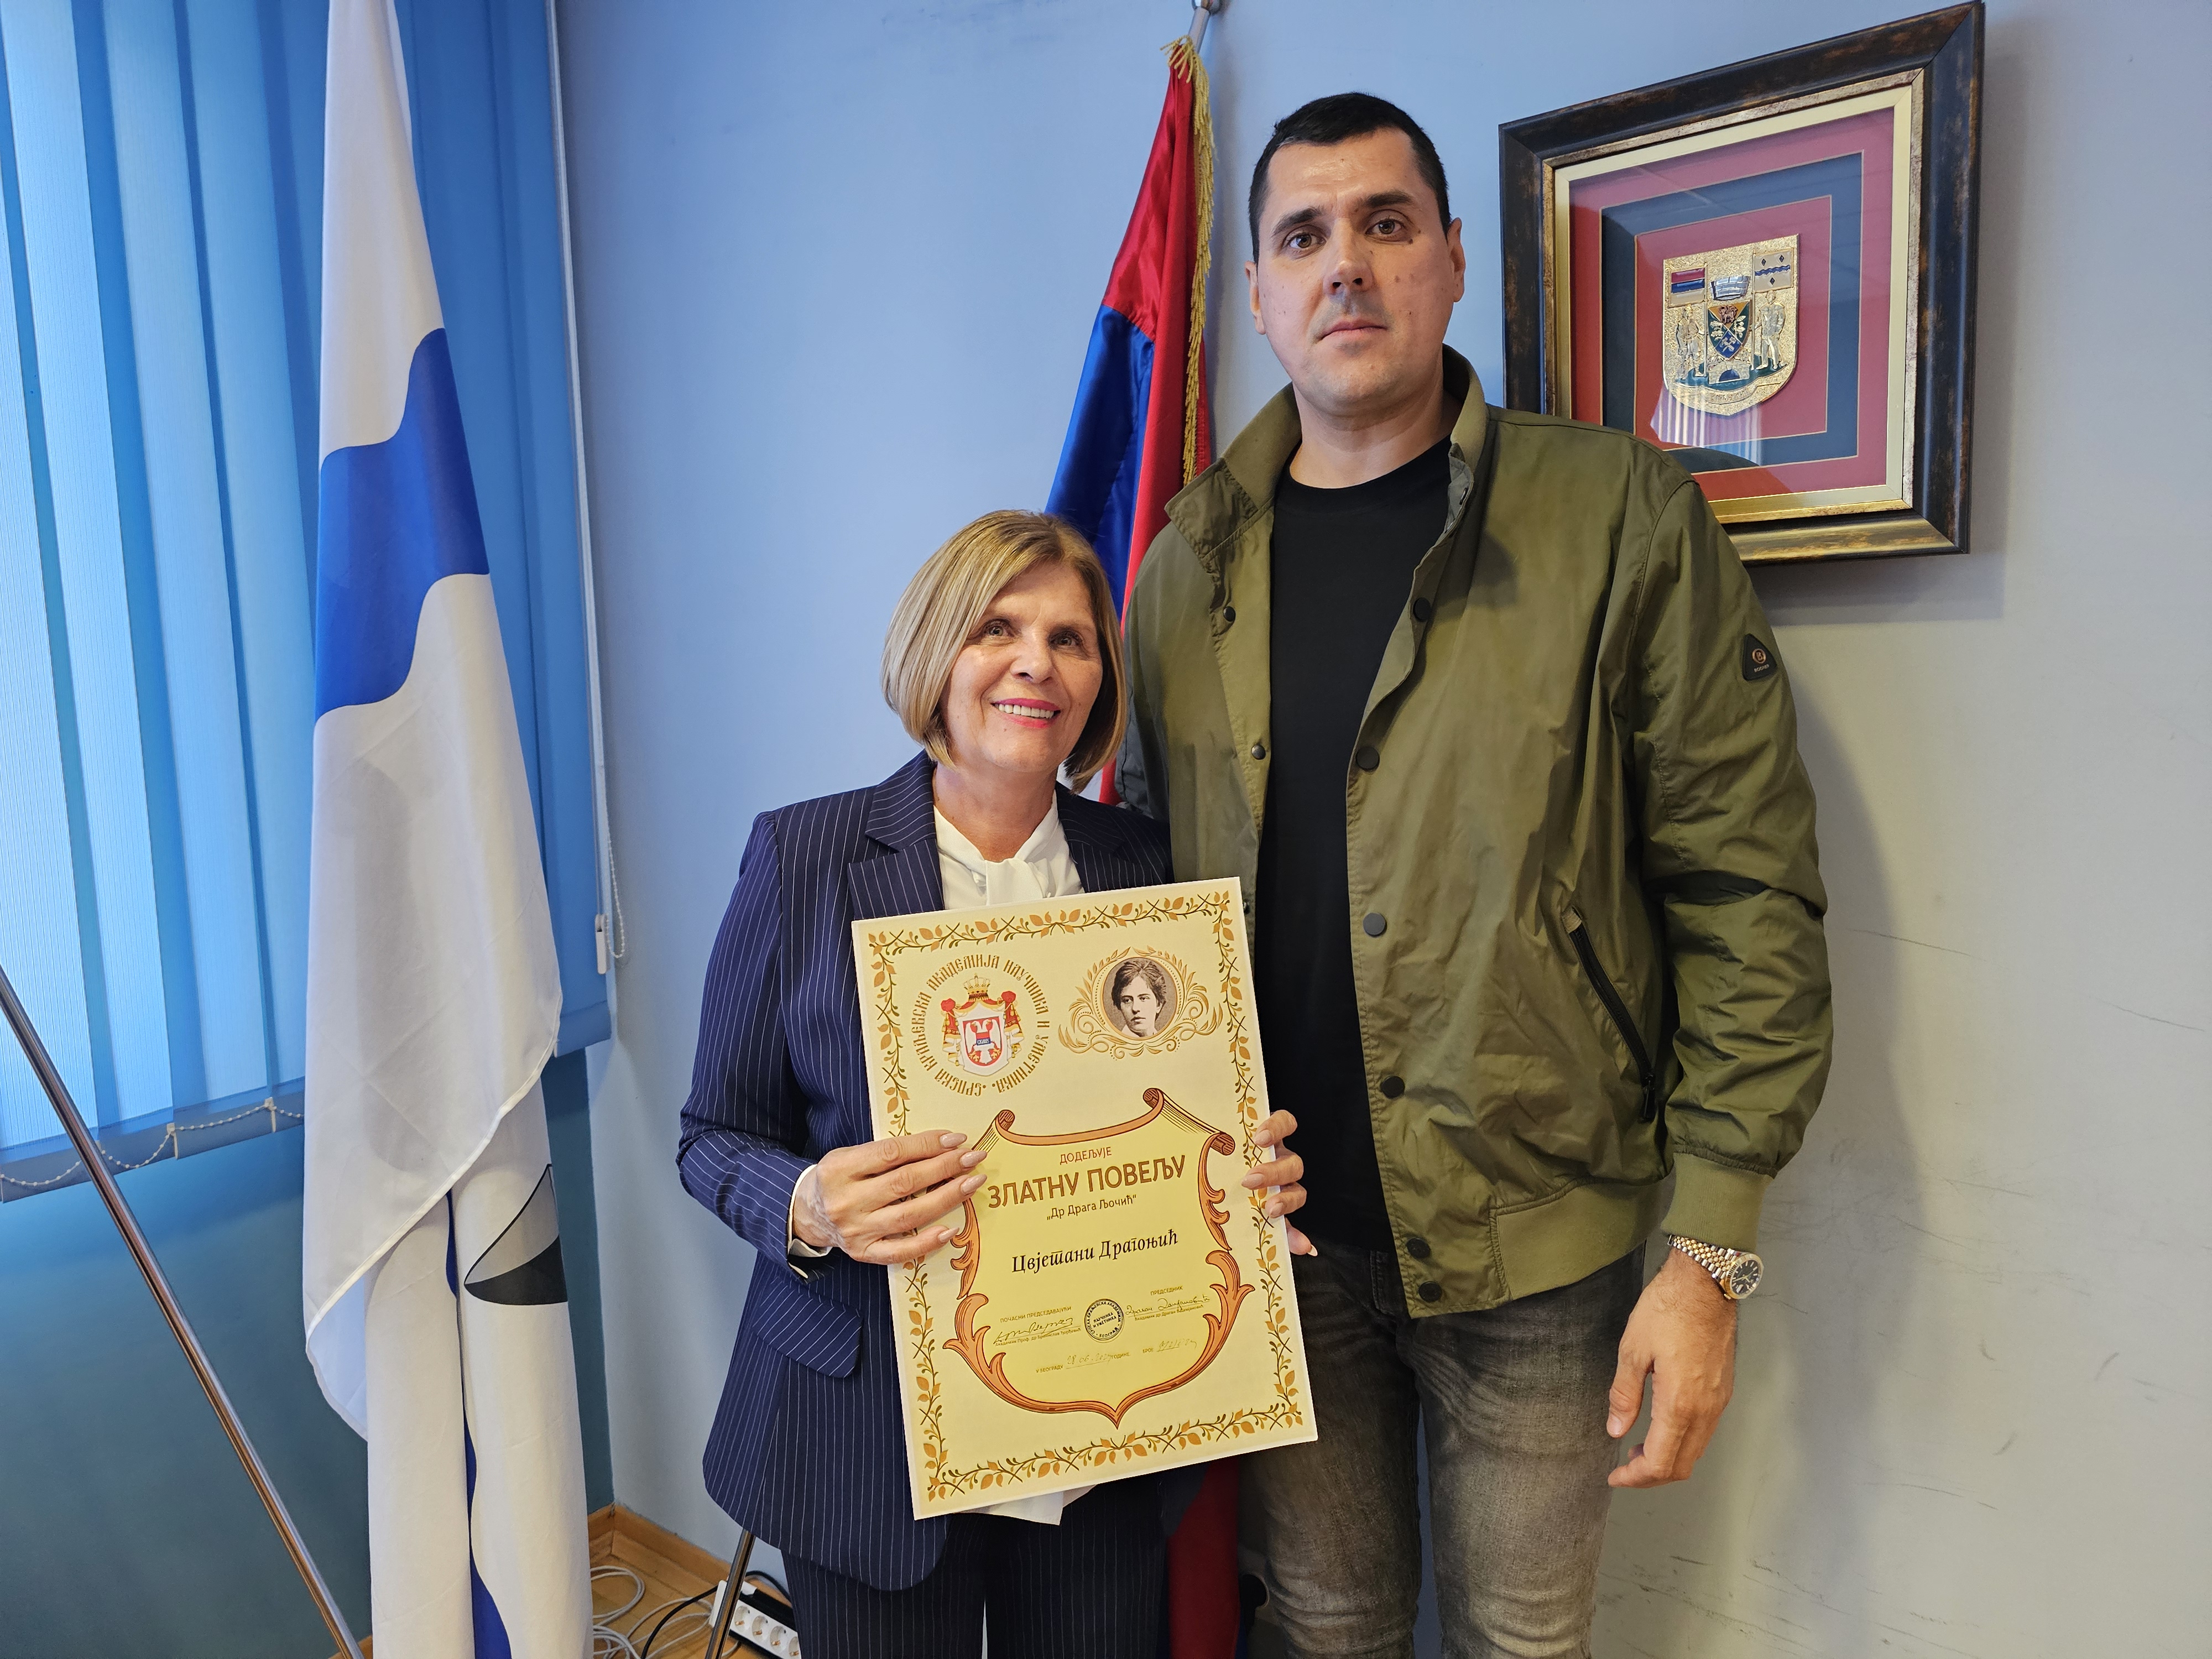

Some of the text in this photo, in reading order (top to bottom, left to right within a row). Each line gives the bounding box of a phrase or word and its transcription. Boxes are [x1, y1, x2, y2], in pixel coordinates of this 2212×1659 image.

[926, 954, 1000, 991] АКАДЕМИЈА
[1003, 959, 1049, 1015] НАУЧНИКА
[911, 992, 938, 1071] КРАЉЕВСКА
[995, 1034, 1048, 1094] УМЕТНИКА
[934, 1068, 982, 1097] СРПСКА
[1060, 1146, 1112, 1165] ДОДЕЉУЈЕ
[987, 1155, 1186, 1208] ЗЛАТНУ ПОВЕЉУ
[1067, 1202, 1097, 1217] Драга
[1011, 1229, 1178, 1274] Цвјетани Драгоњић
[1150, 1285, 1183, 1296] ПРЕДСЕДНИК
[1000, 1306, 1072, 1323] ПОЧАСНИ ПРЕДСЕДАВАЈУЋИ
[1040, 1364, 1063, 1373] БЕОГРАДУ
